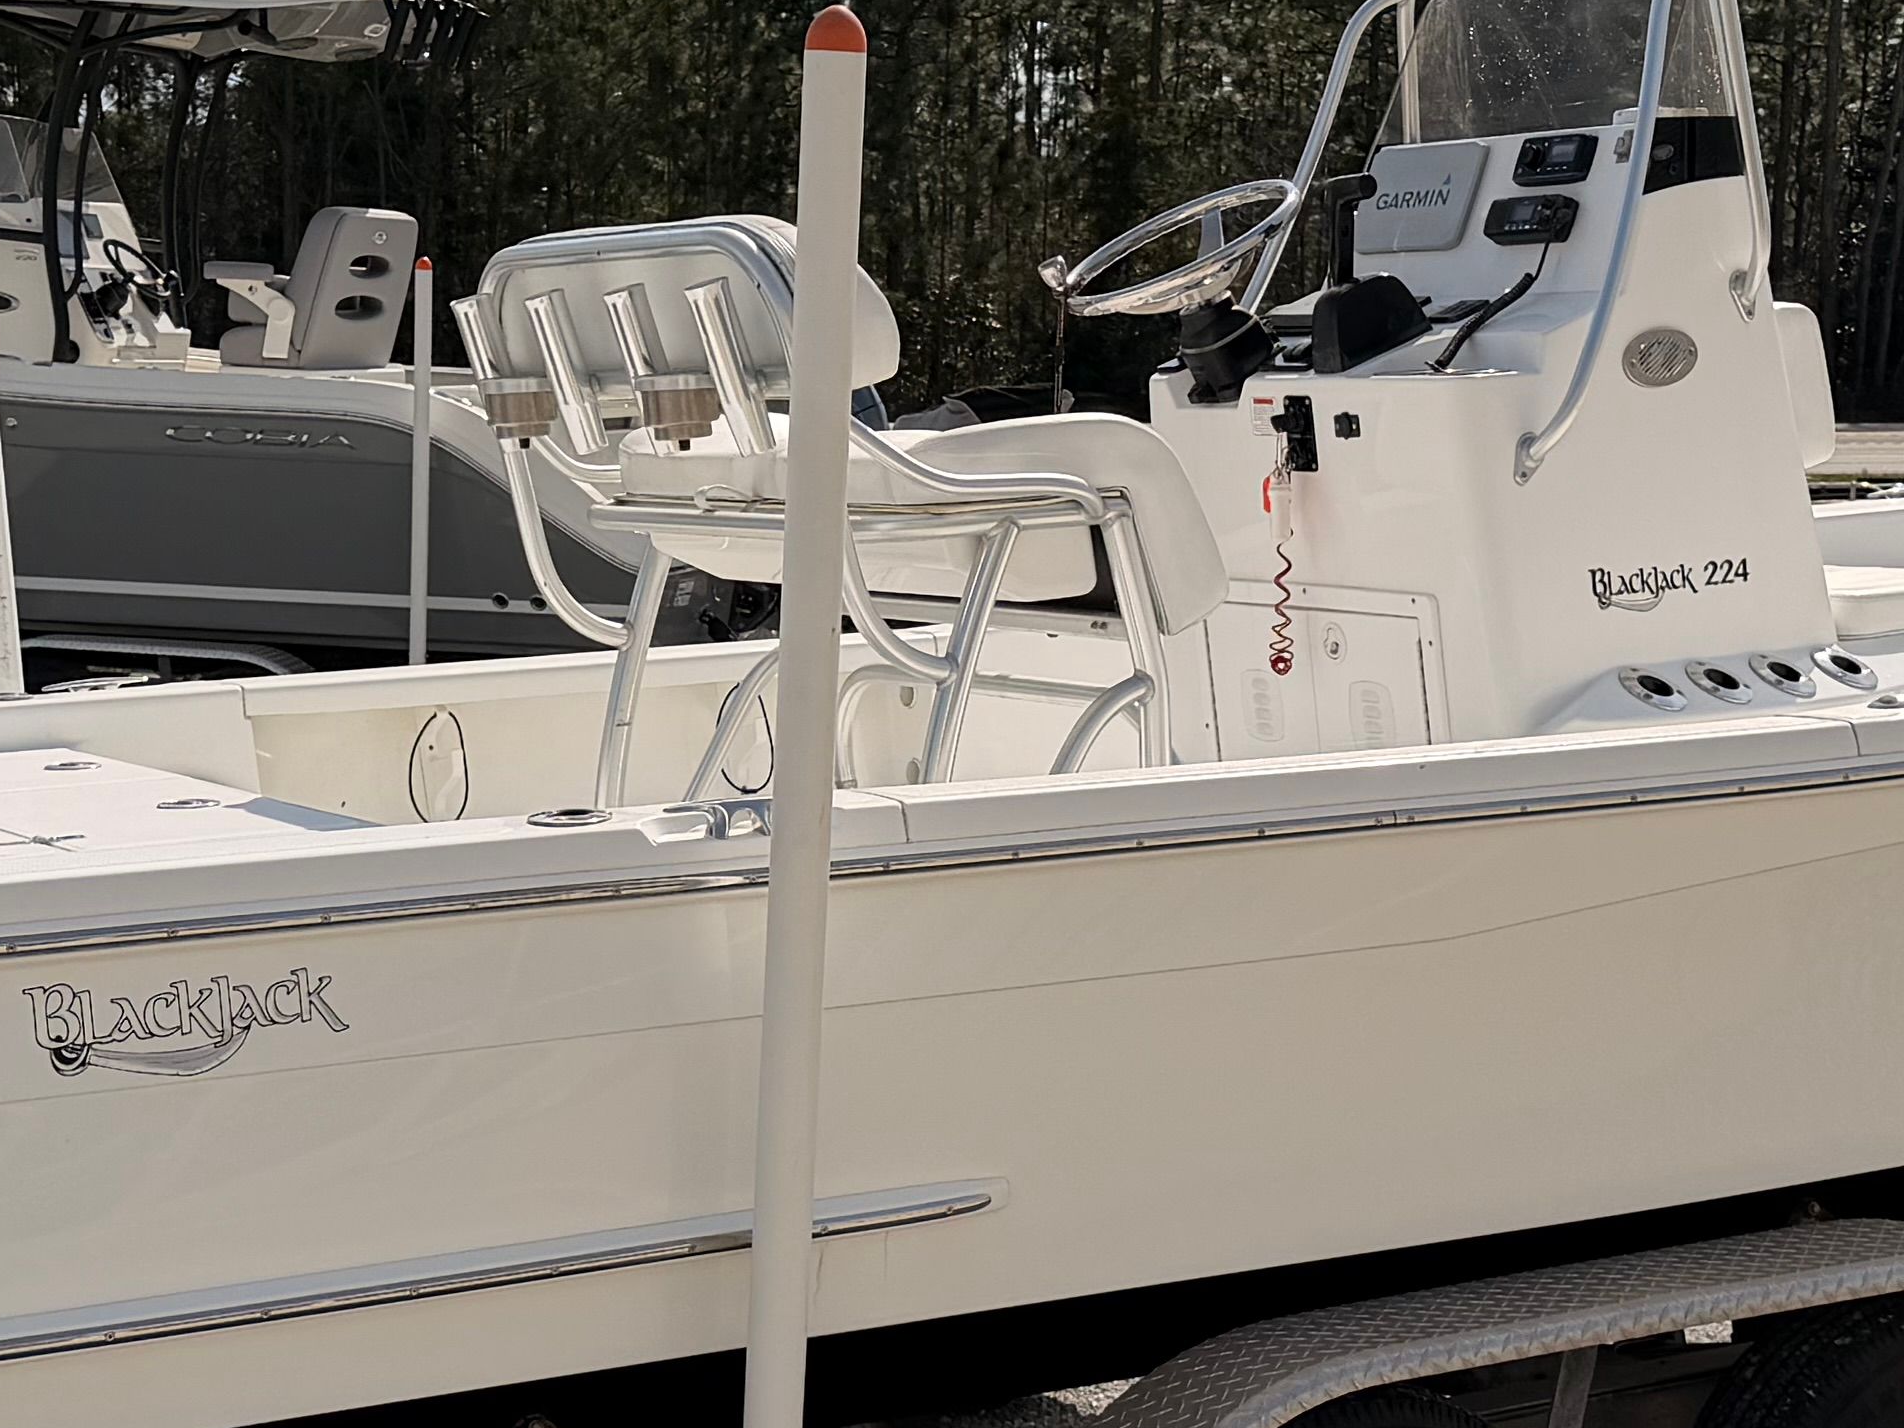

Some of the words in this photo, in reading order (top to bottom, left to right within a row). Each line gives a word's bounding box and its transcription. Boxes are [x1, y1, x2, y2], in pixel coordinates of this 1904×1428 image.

[1375, 188, 1451, 211] GARMIN
[165, 424, 357, 451] COBIA
[1703, 558, 1751, 586] 224
